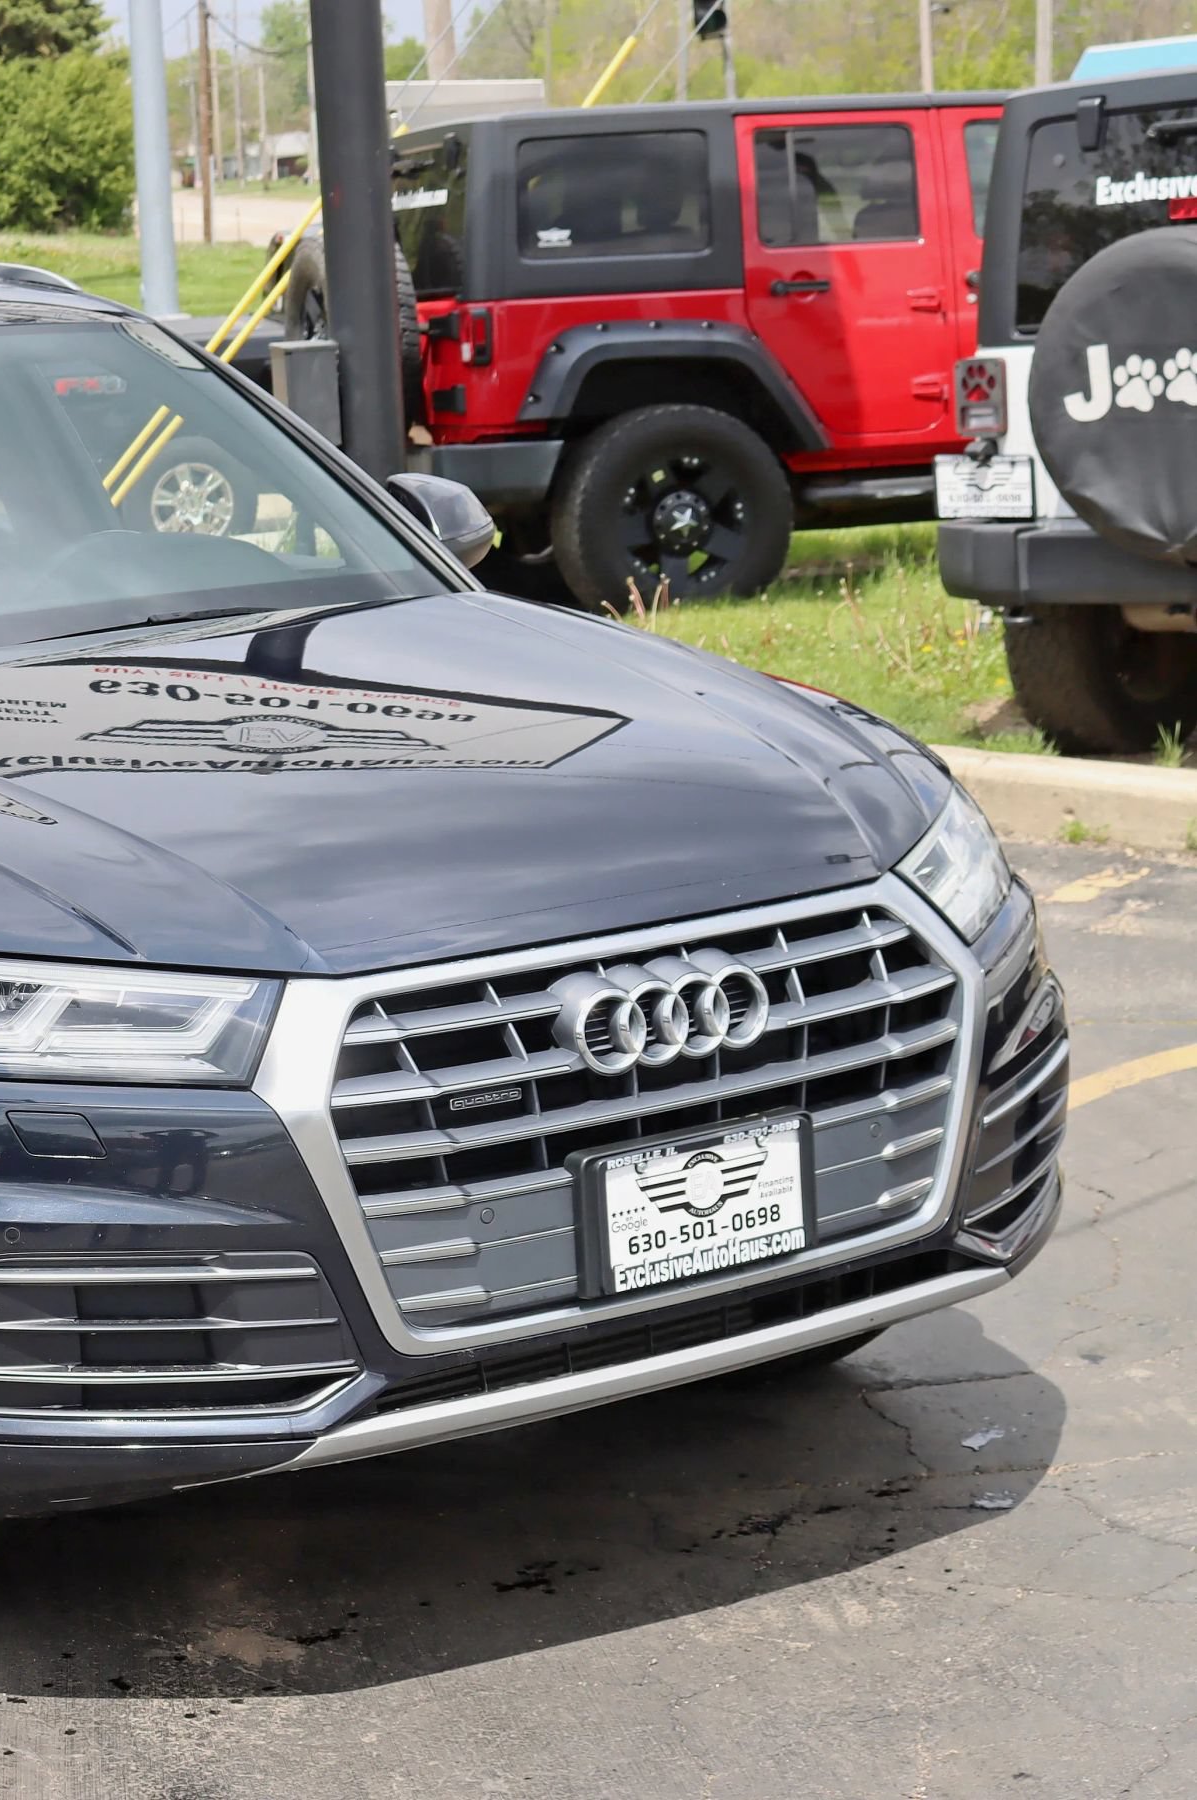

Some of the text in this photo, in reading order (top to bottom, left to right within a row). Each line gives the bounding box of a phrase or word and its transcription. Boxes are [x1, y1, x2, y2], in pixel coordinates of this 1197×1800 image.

[454, 1090, 520, 1109] quattro
[723, 1119, 801, 1144] 630-501-0698
[611, 1217, 649, 1233] Google
[628, 1203, 781, 1255] 630-501-0698
[614, 1228, 806, 1293] ExclusiveAutoHaus.com
